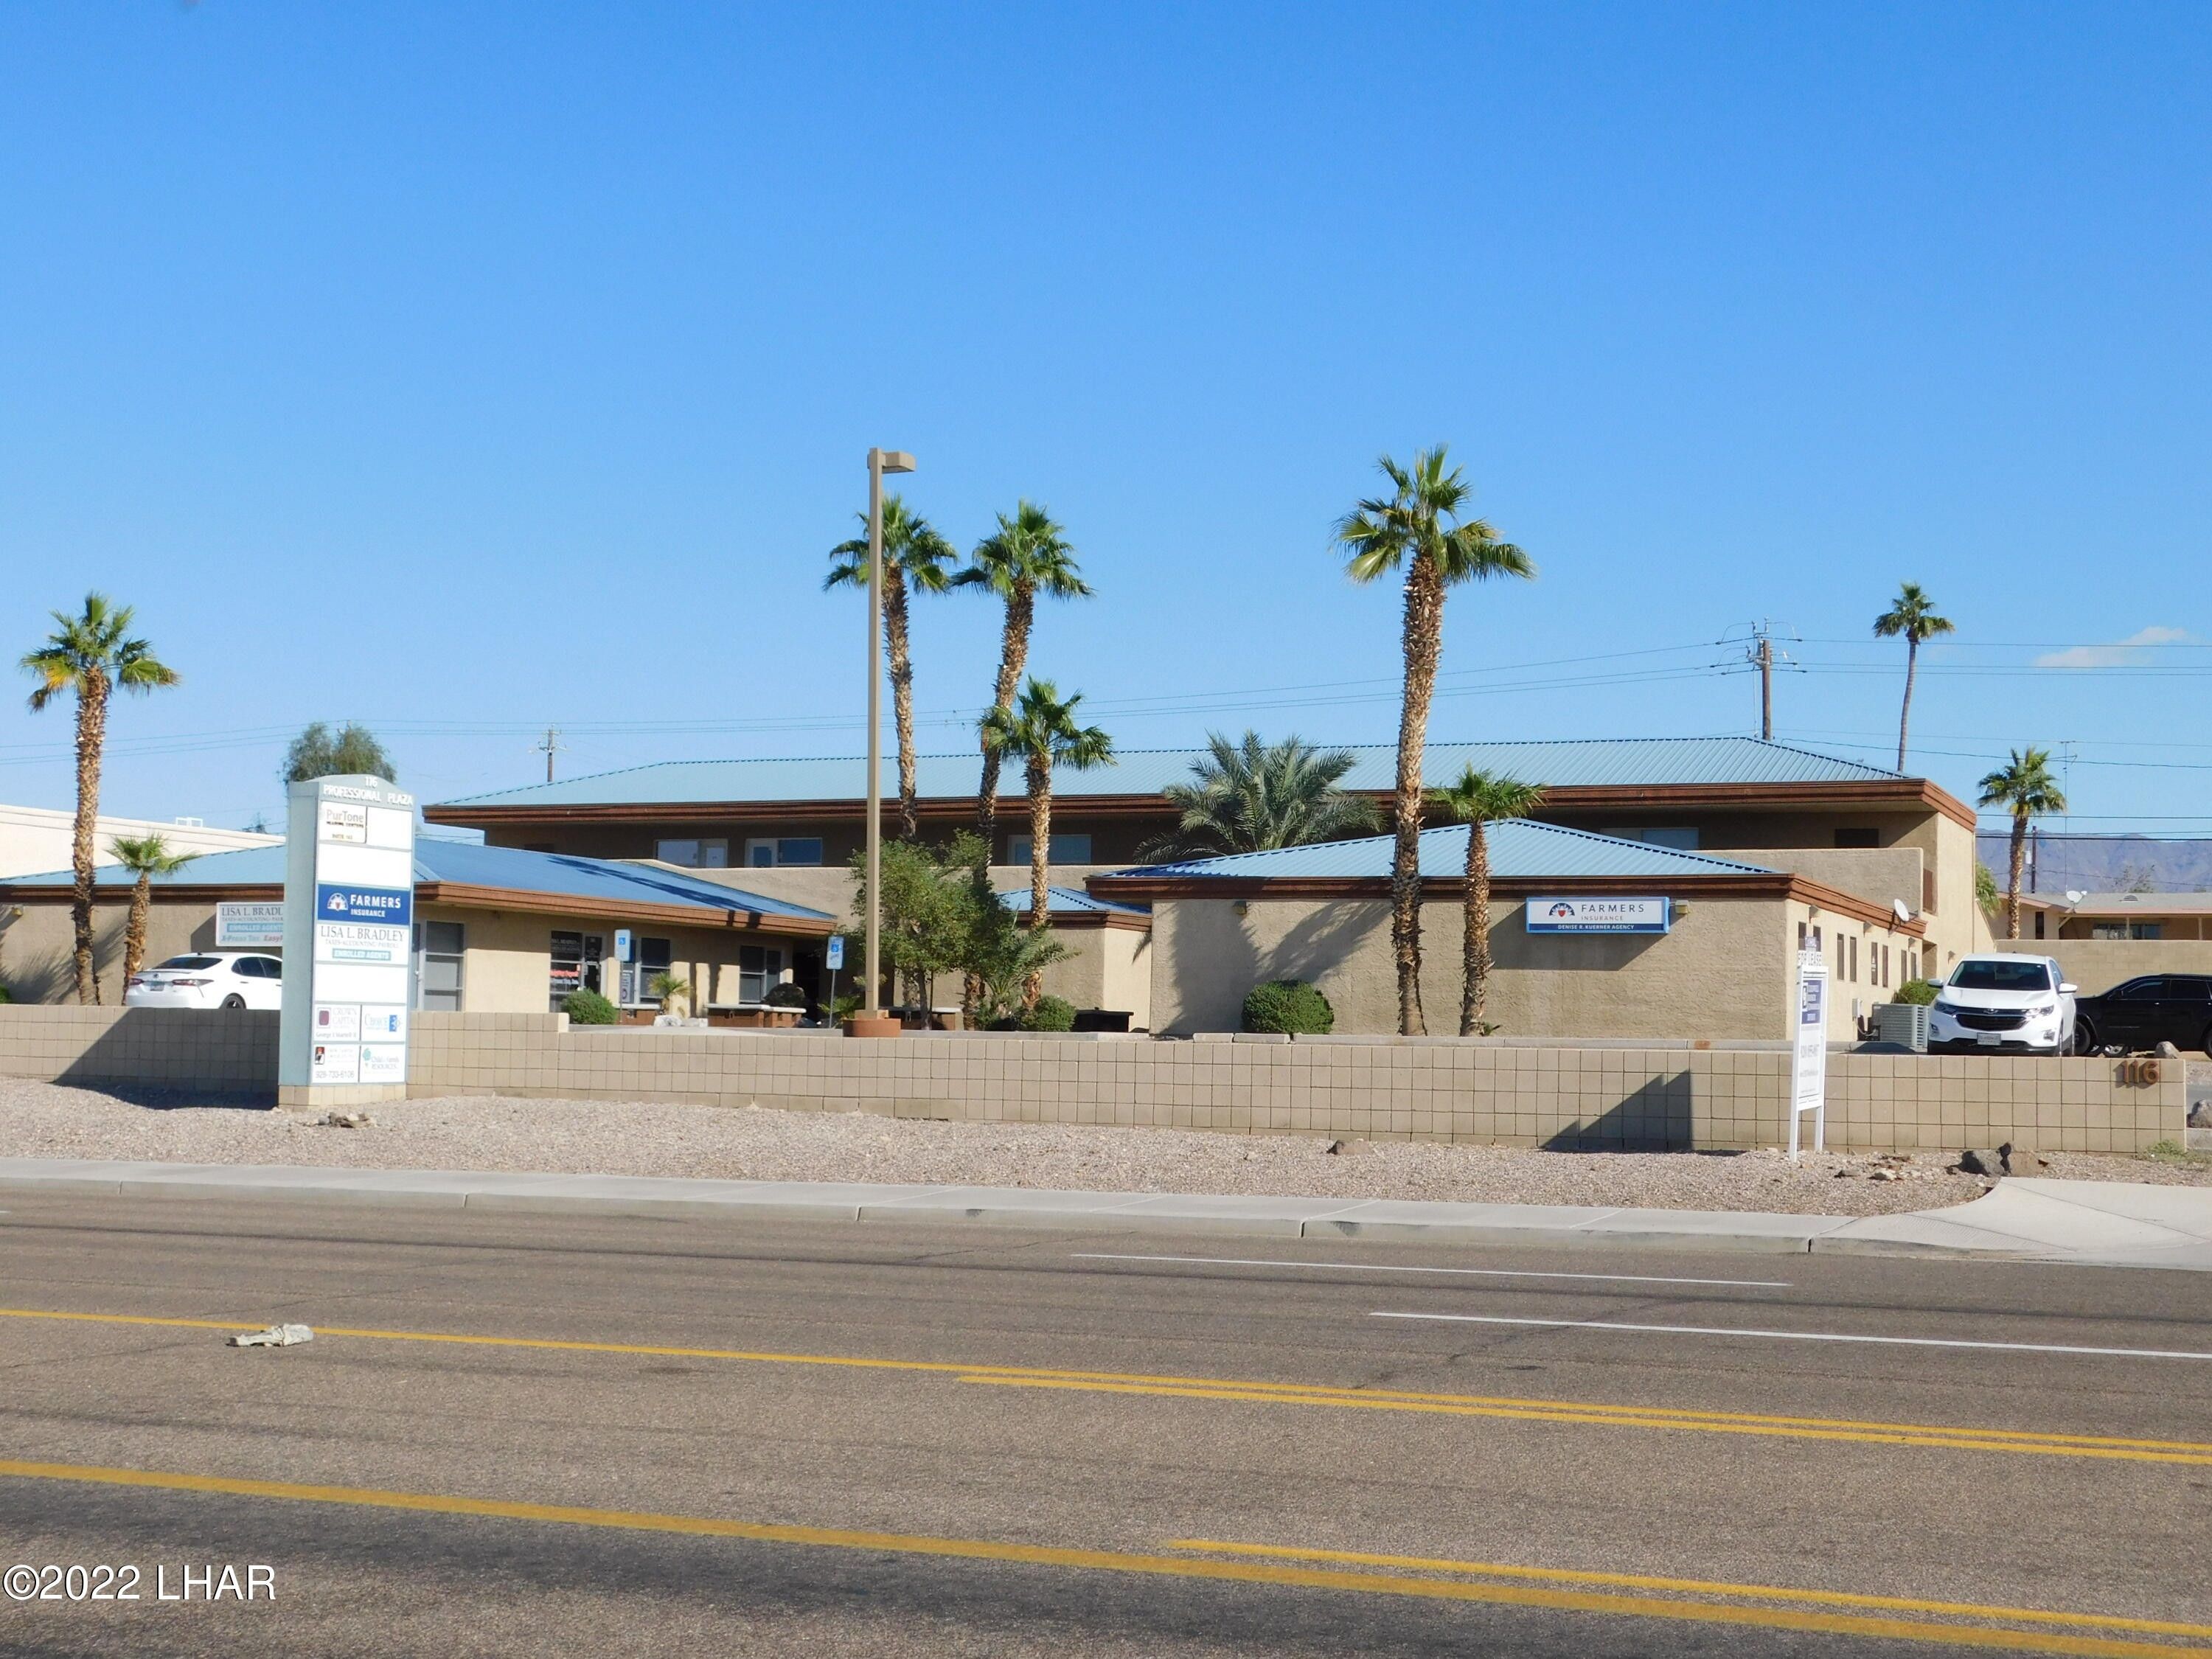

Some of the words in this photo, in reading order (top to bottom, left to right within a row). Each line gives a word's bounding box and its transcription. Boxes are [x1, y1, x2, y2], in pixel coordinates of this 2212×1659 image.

[365, 776, 378, 787] 116
[323, 785, 381, 802] PROFESSIONAL
[388, 793, 413, 805] PLAZA
[326, 809, 364, 823] PurTone
[350, 894, 401, 908] FARMERS
[221, 907, 241, 916] LISA
[252, 907, 283, 916] BRADL
[350, 908, 386, 917] INSURANCE
[1581, 904, 1645, 913] FARMERS
[320, 925, 344, 938] LISA
[357, 928, 405, 942] BRADLEY
[2122, 1060, 2160, 1085] 116
